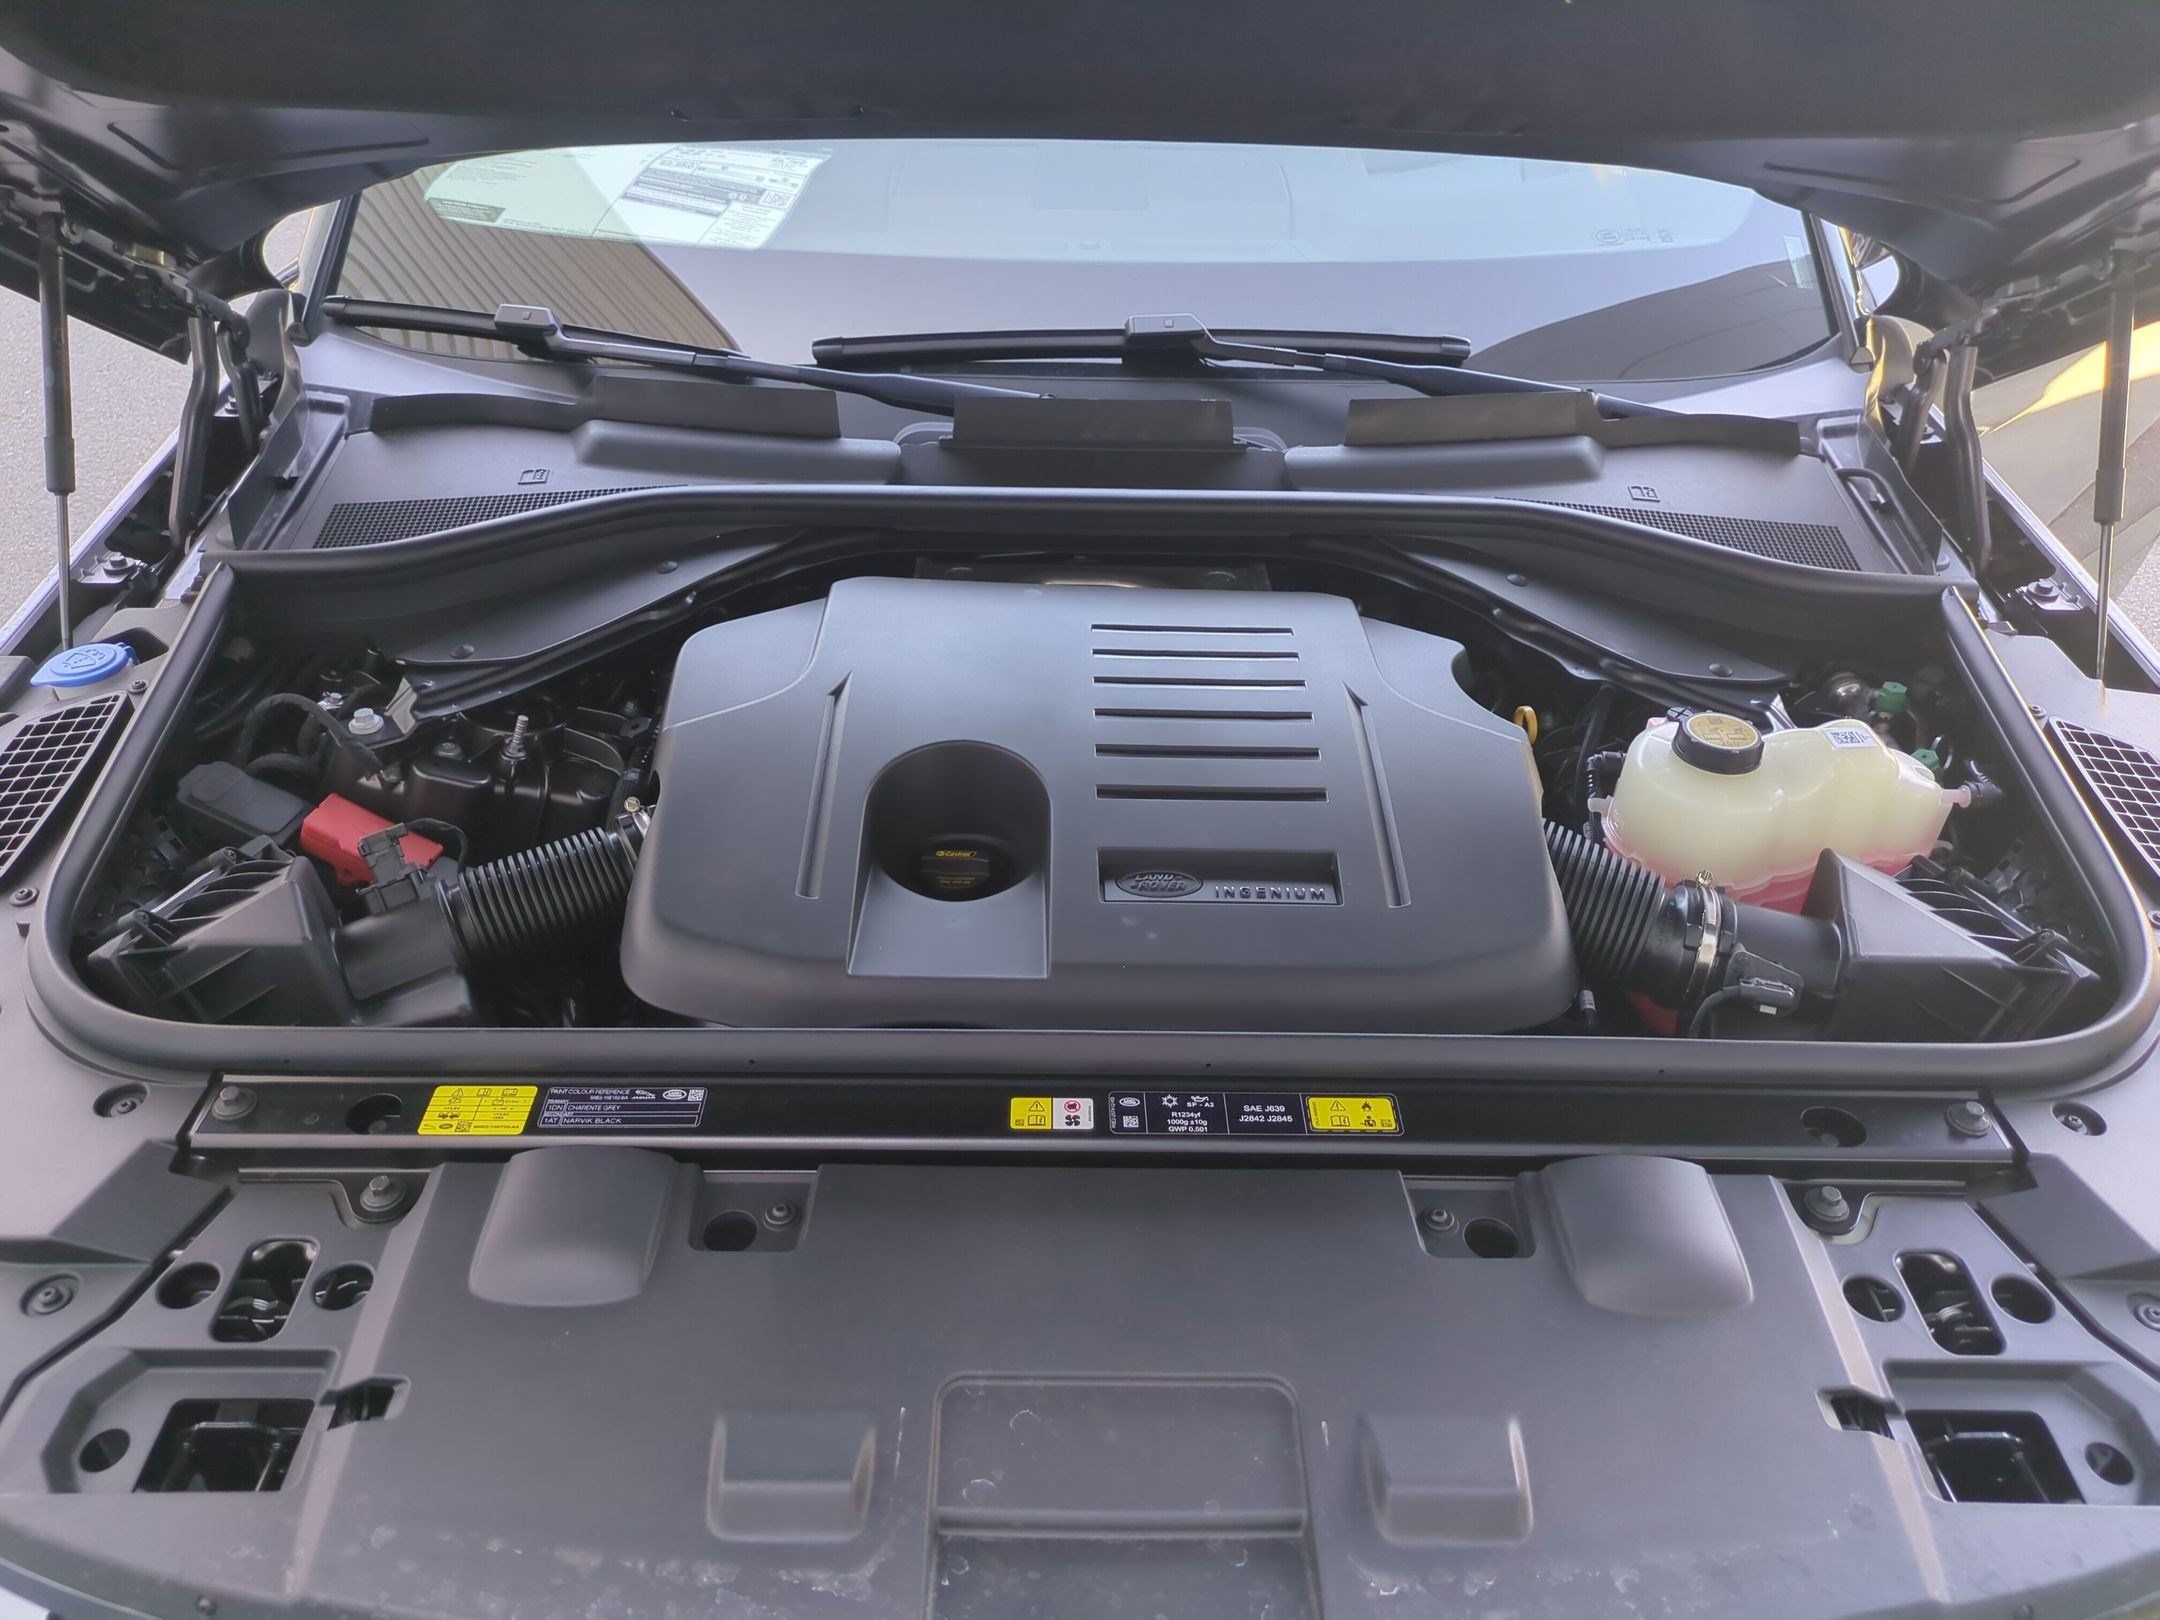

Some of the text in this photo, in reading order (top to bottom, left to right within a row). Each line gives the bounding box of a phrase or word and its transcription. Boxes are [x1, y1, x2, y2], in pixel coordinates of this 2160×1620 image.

[1135, 872, 1175, 882] LAND
[1215, 885, 1325, 900] INGENIUM
[1243, 1105, 1286, 1113] SAE J639
[1238, 1115, 1294, 1123] J2842 J2845
